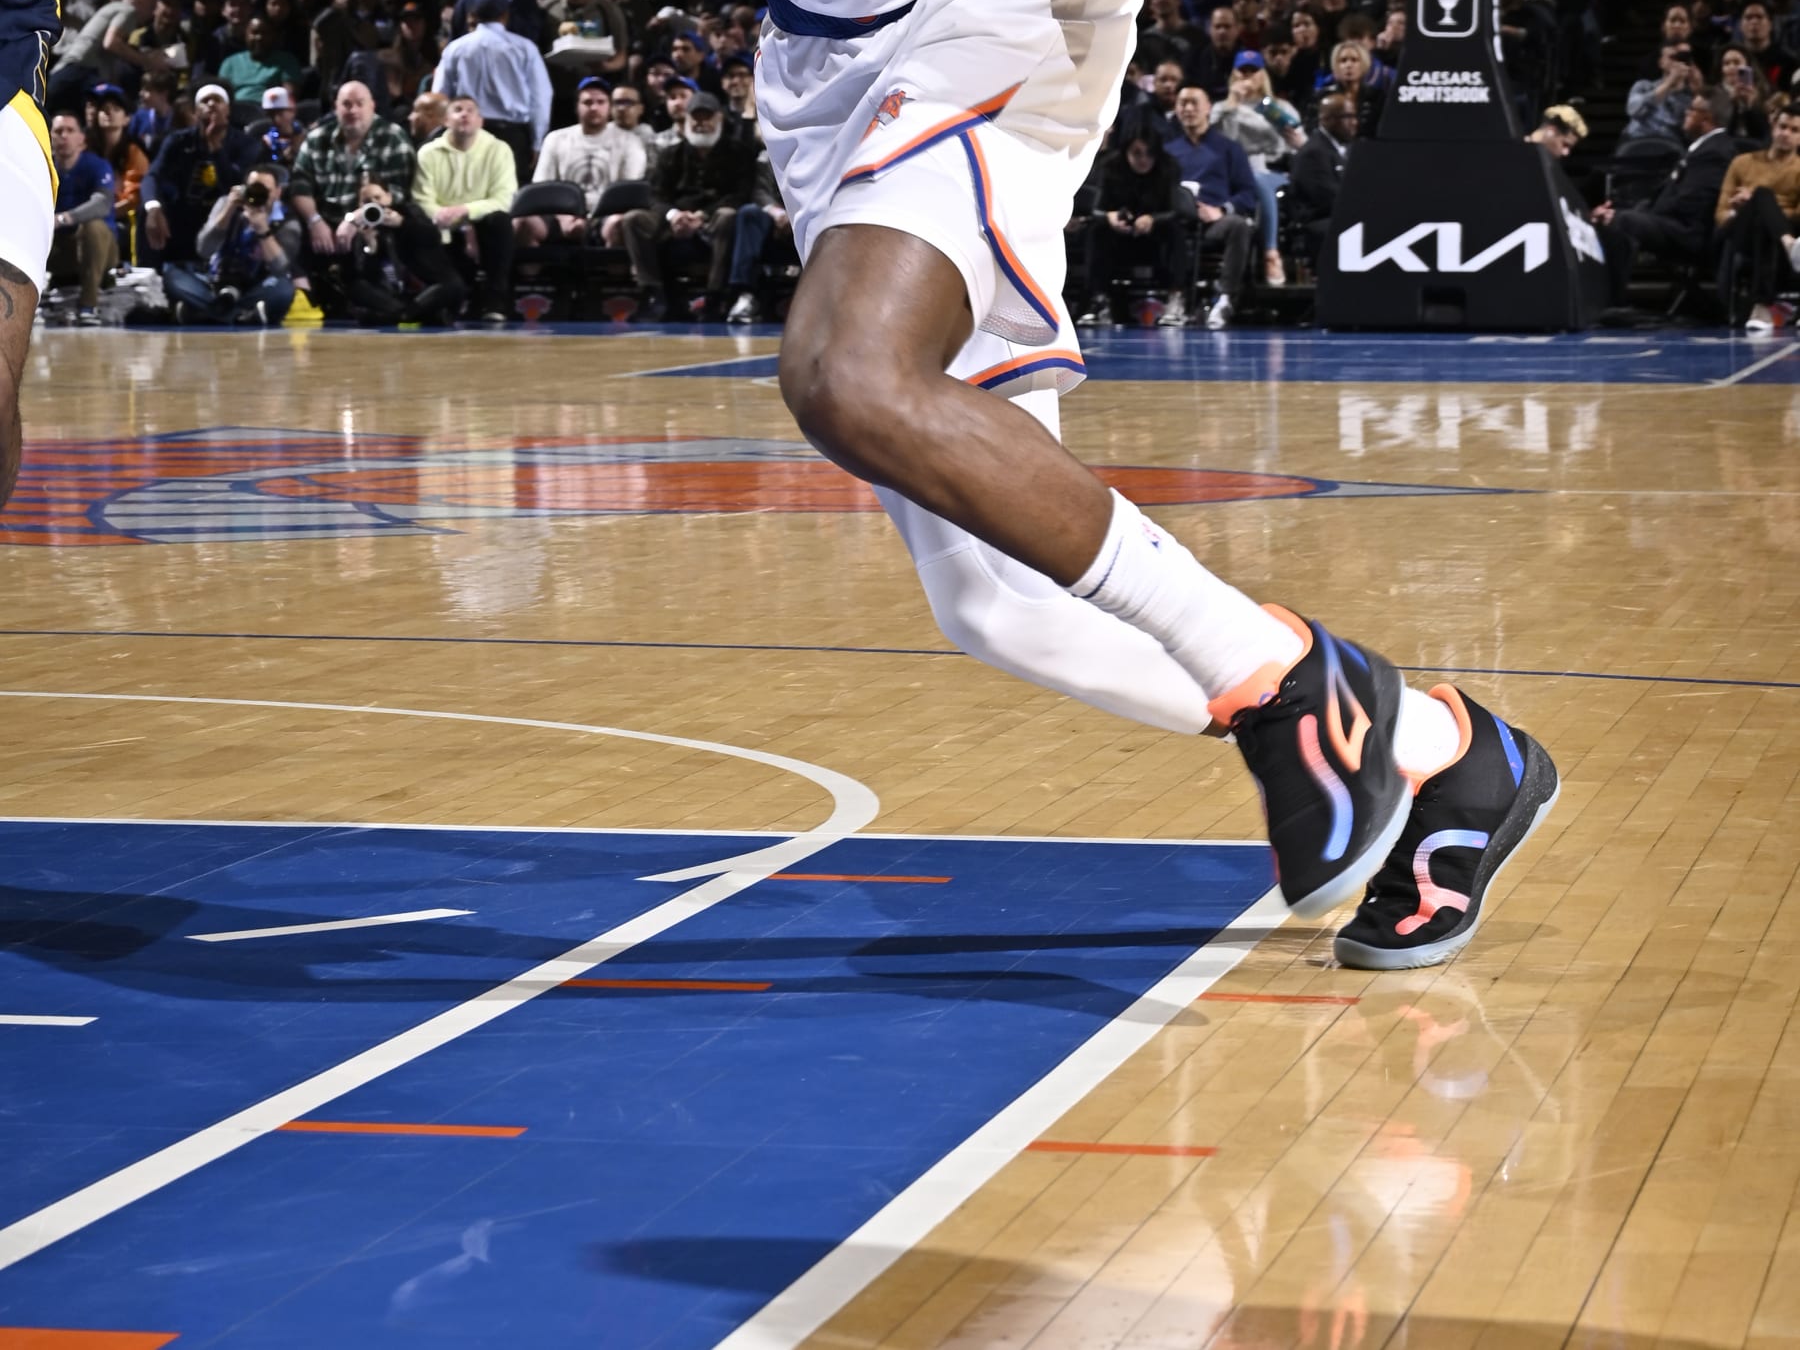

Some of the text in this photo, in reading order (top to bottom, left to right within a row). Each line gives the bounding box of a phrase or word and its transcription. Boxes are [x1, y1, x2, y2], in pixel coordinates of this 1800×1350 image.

[1406, 70, 1484, 86] CAESARS
[1397, 85, 1490, 103] SPORTSBOOK
[1338, 221, 1550, 273] KIA
